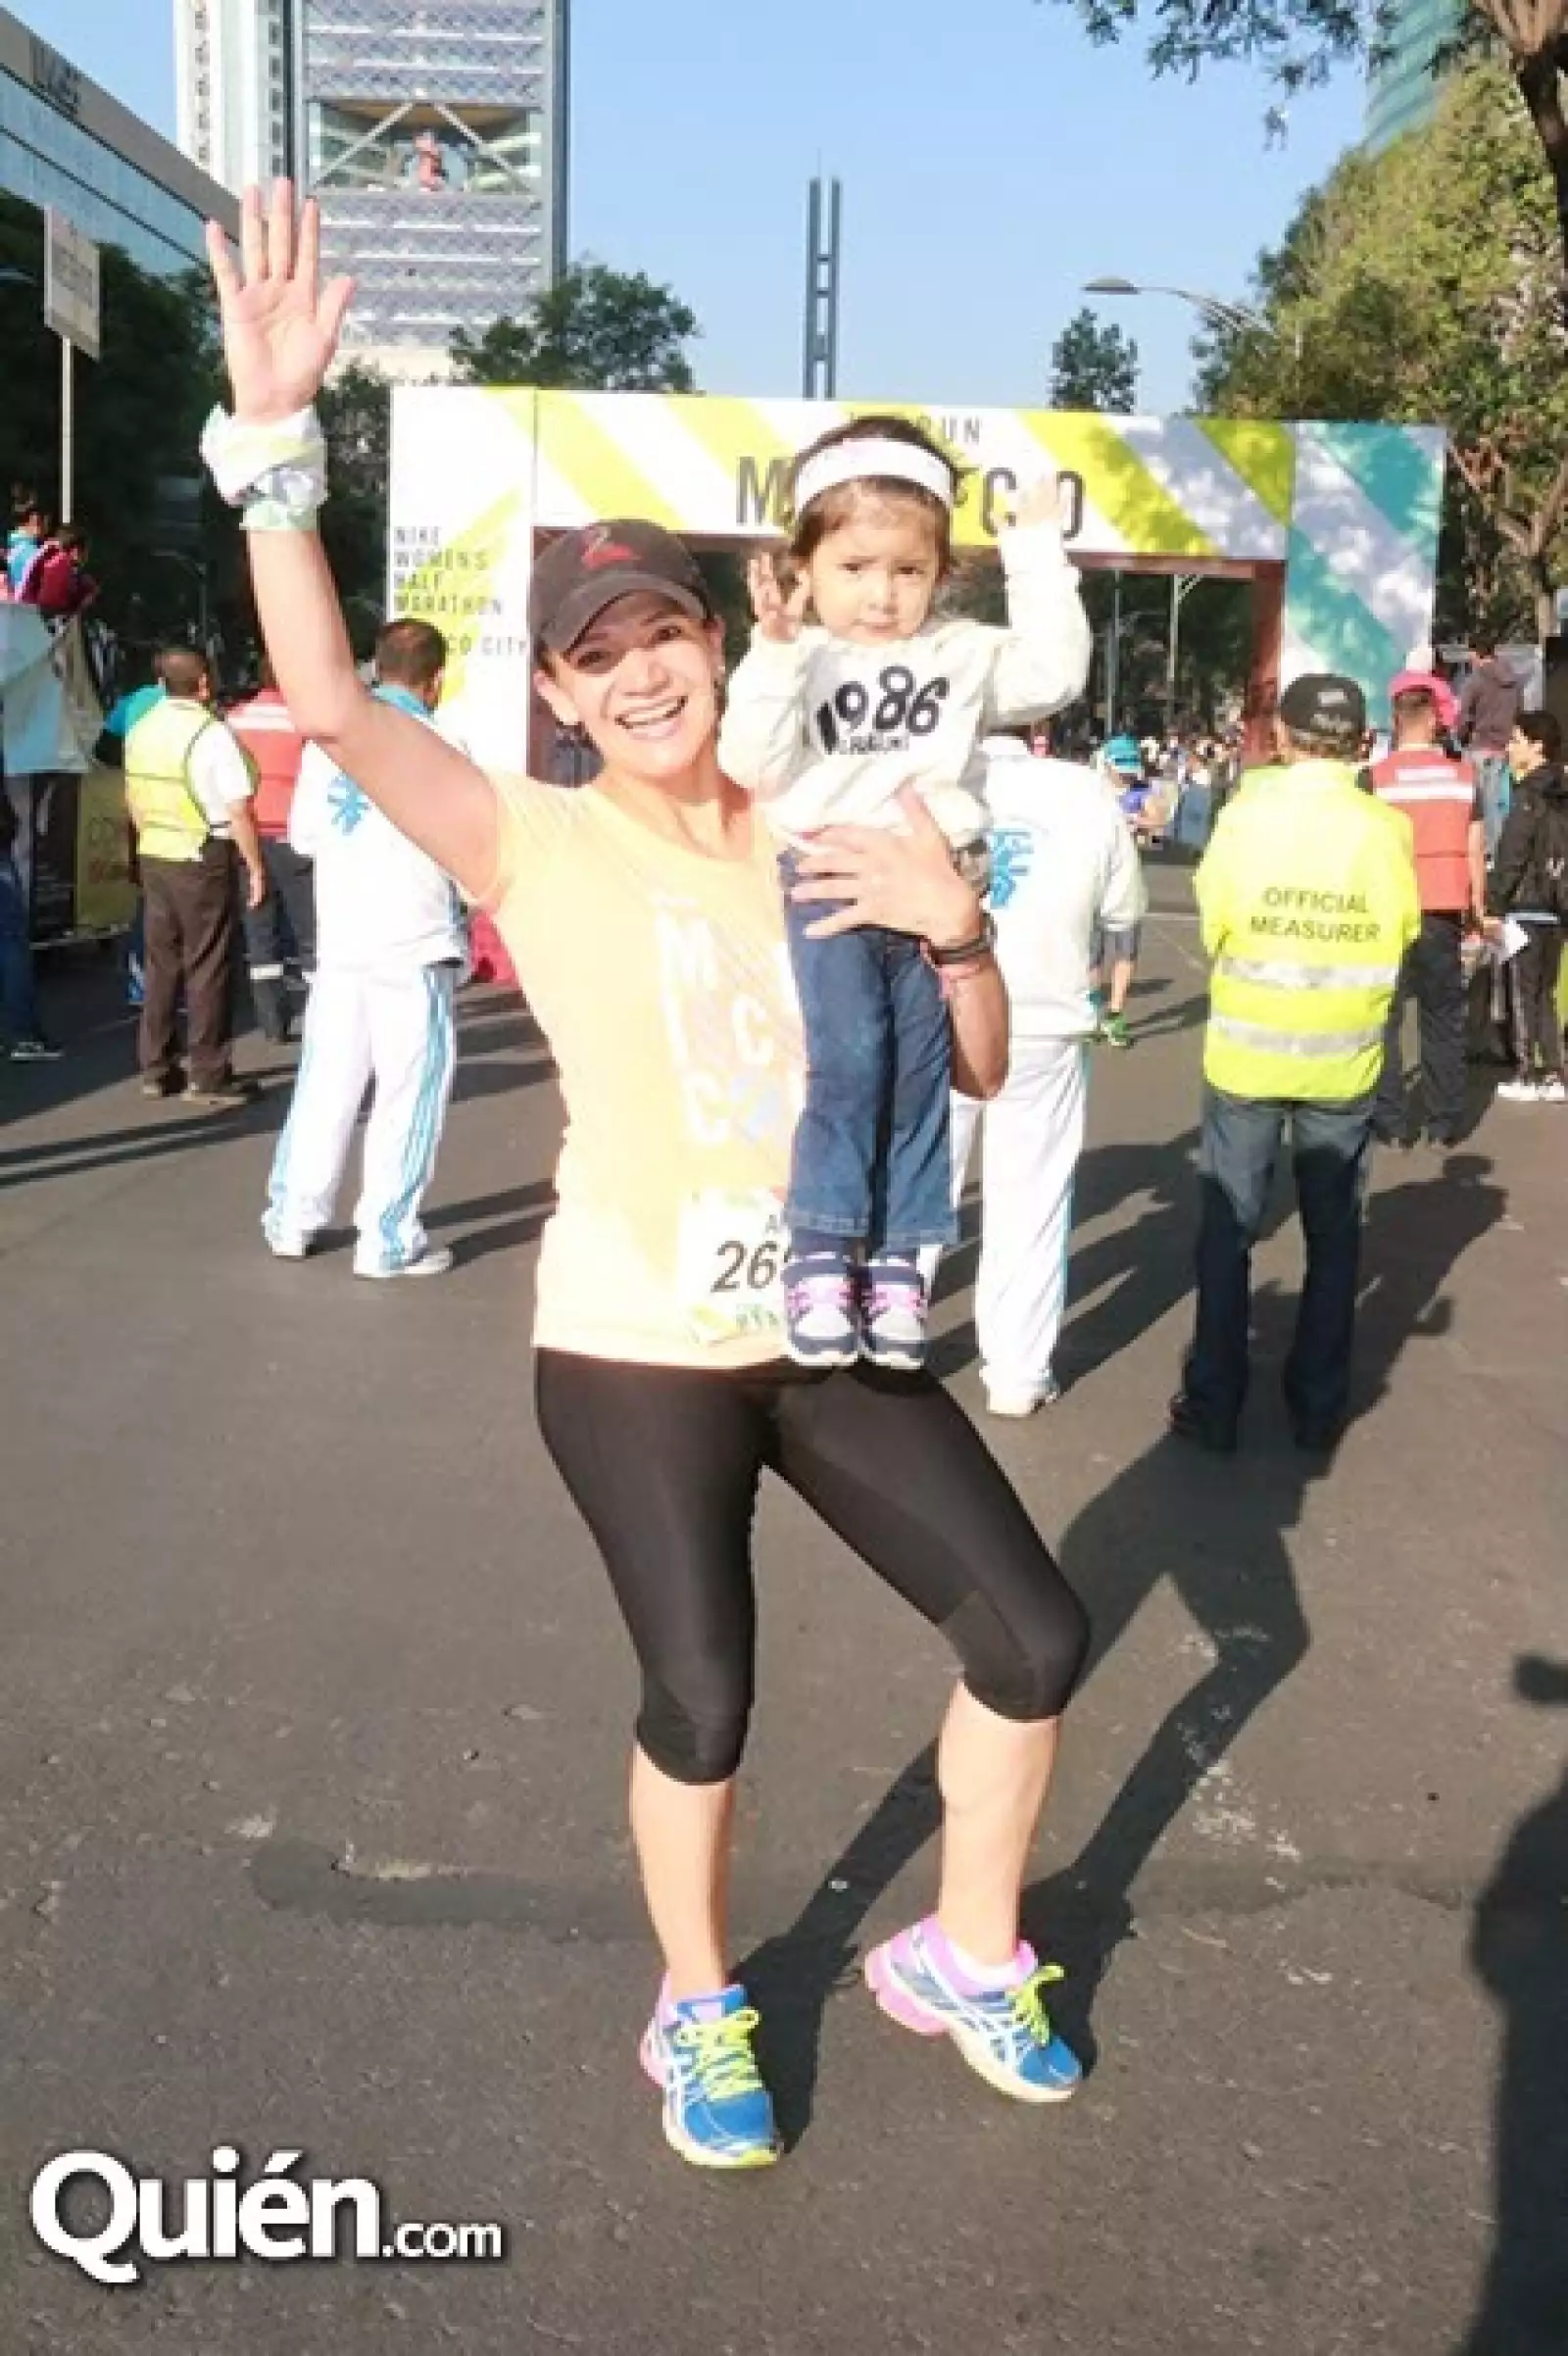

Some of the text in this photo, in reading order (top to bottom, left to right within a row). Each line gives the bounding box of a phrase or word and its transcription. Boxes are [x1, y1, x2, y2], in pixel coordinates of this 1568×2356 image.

[394, 526, 440, 545] NIKE
[394, 593, 503, 614] MARATHON
[816, 665, 950, 755] 1986
[1262, 886, 1369, 913] OFFICIAL
[1250, 916, 1382, 943] MEASURER
[710, 1240, 790, 1293] 26
